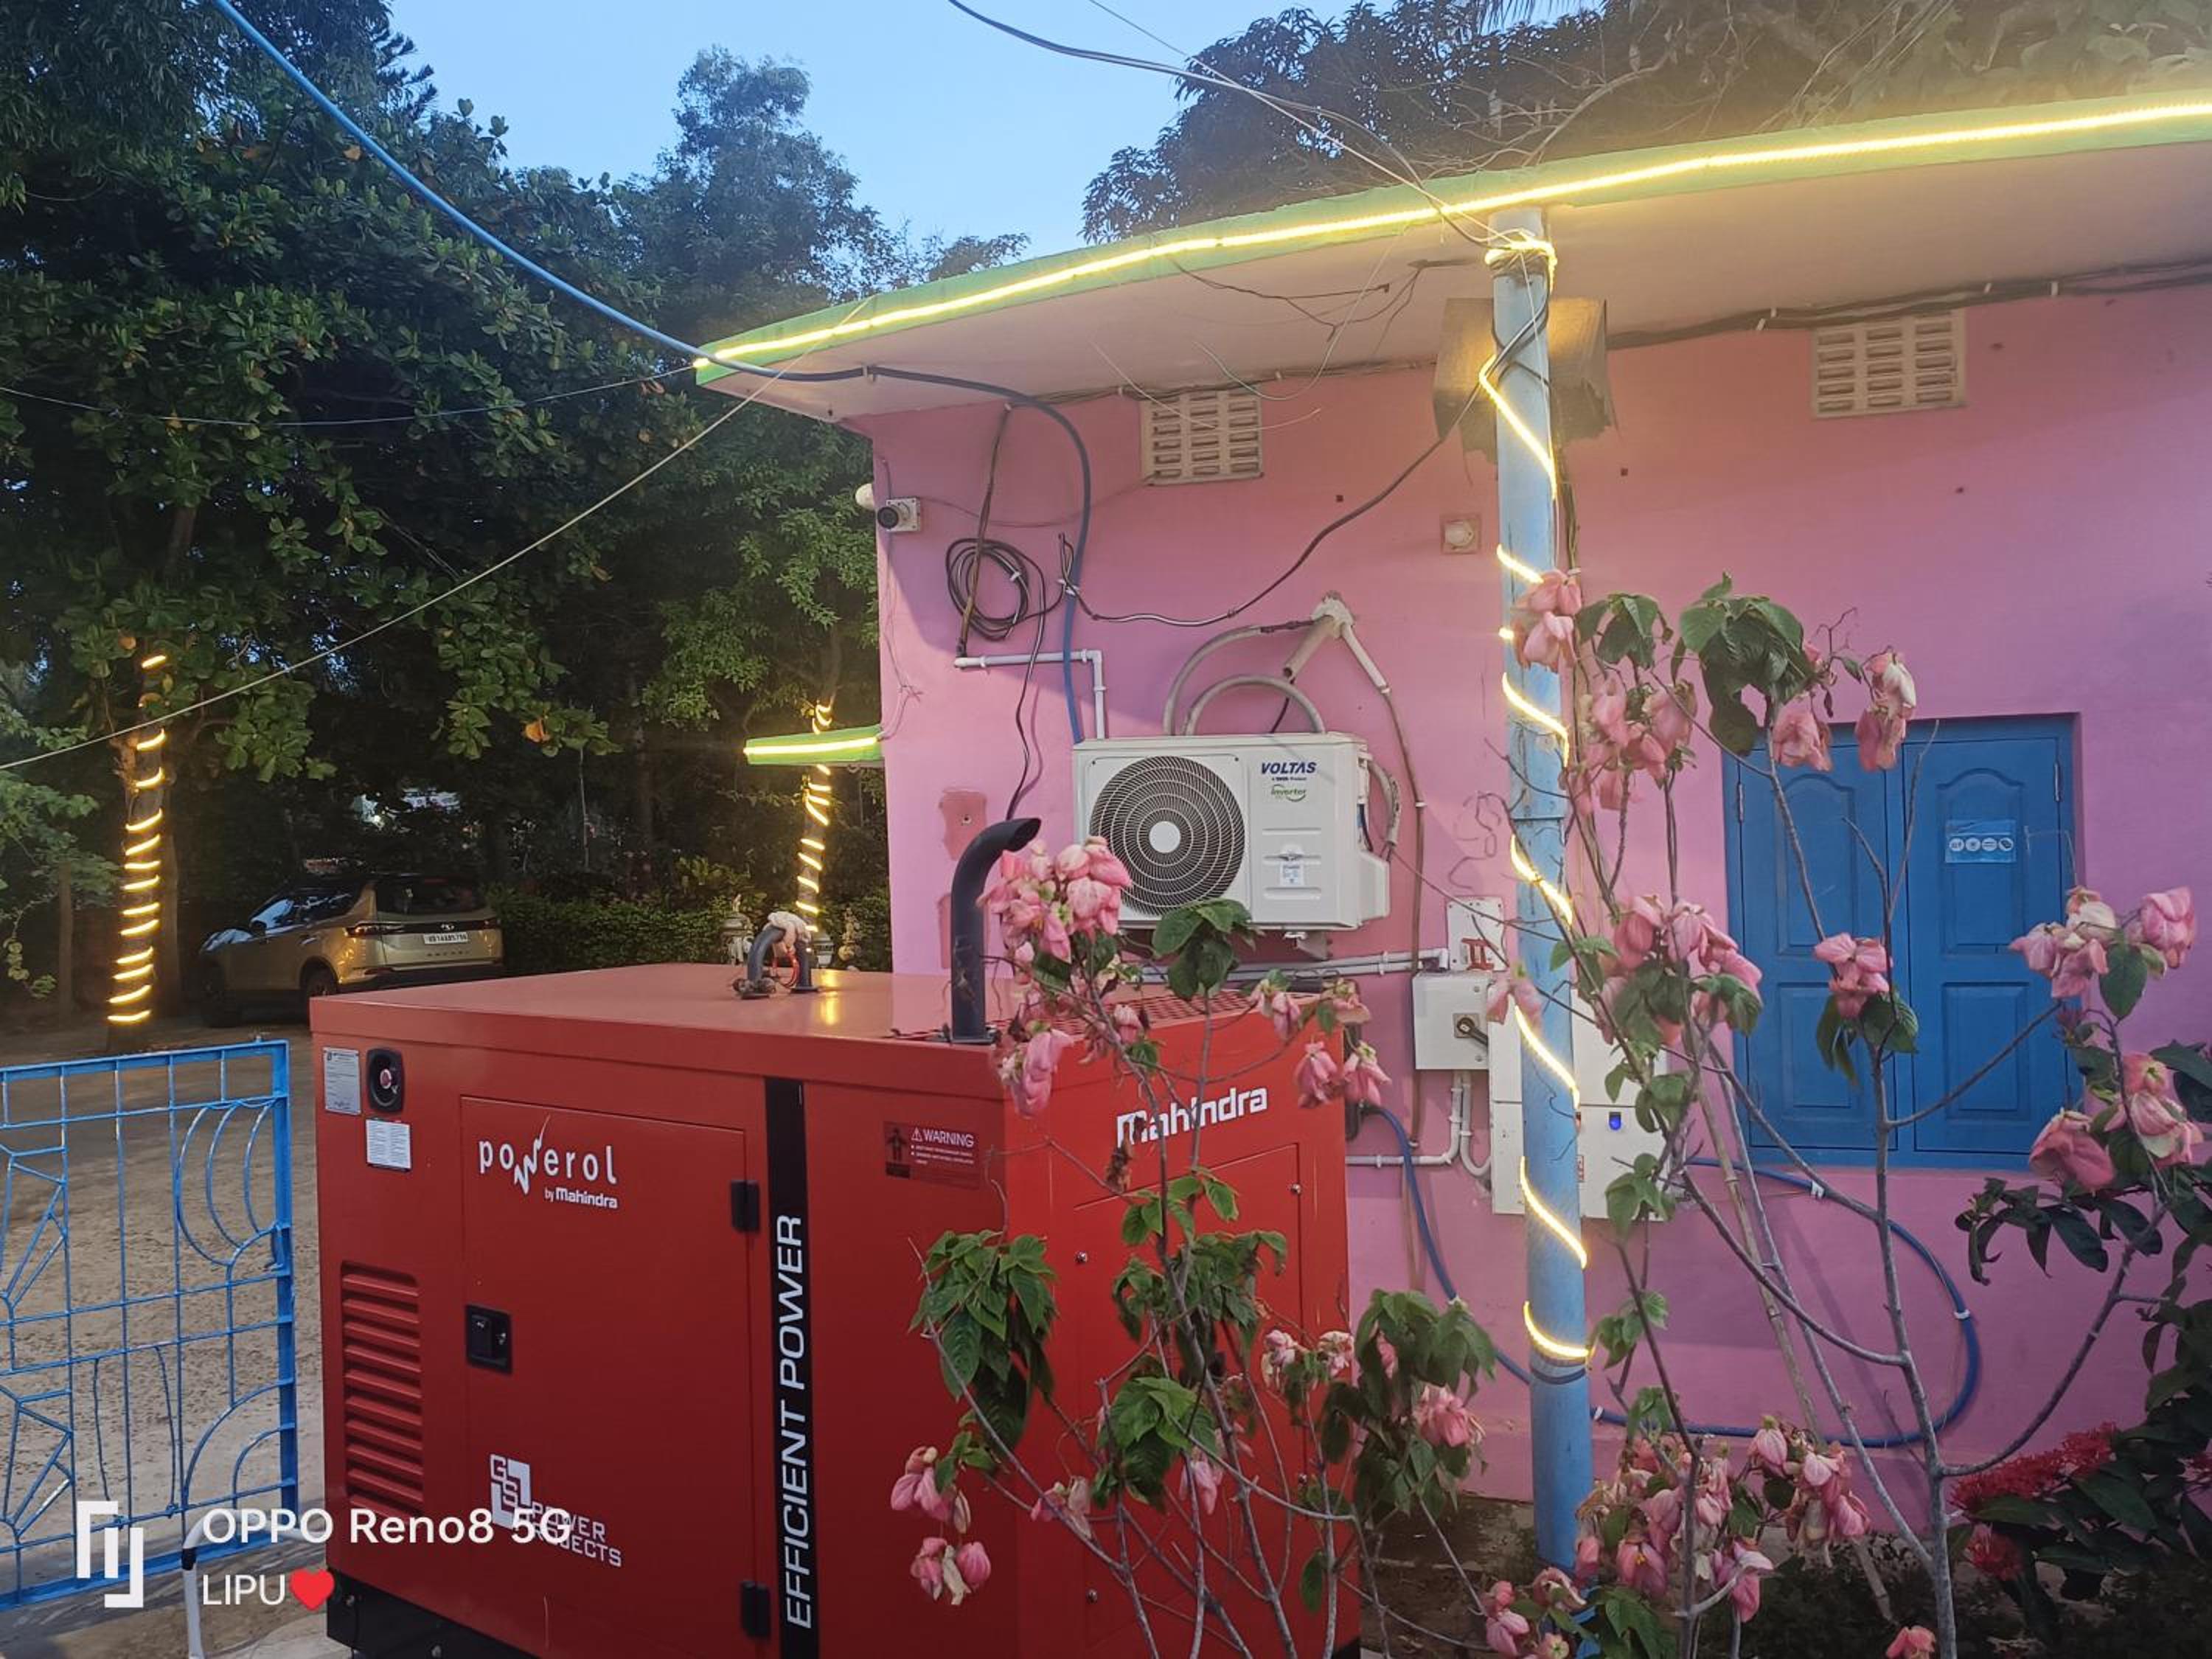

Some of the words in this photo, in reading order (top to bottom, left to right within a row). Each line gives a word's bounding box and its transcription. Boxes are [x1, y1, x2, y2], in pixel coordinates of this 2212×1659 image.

[1261, 762, 1317, 774] VOLTAS
[923, 1129, 974, 1148] WARNING
[545, 1187, 554, 1203] by
[555, 1186, 619, 1209] Mahindra
[776, 1214, 806, 1390] POWER
[781, 1399, 812, 1629] EFFICIENT
